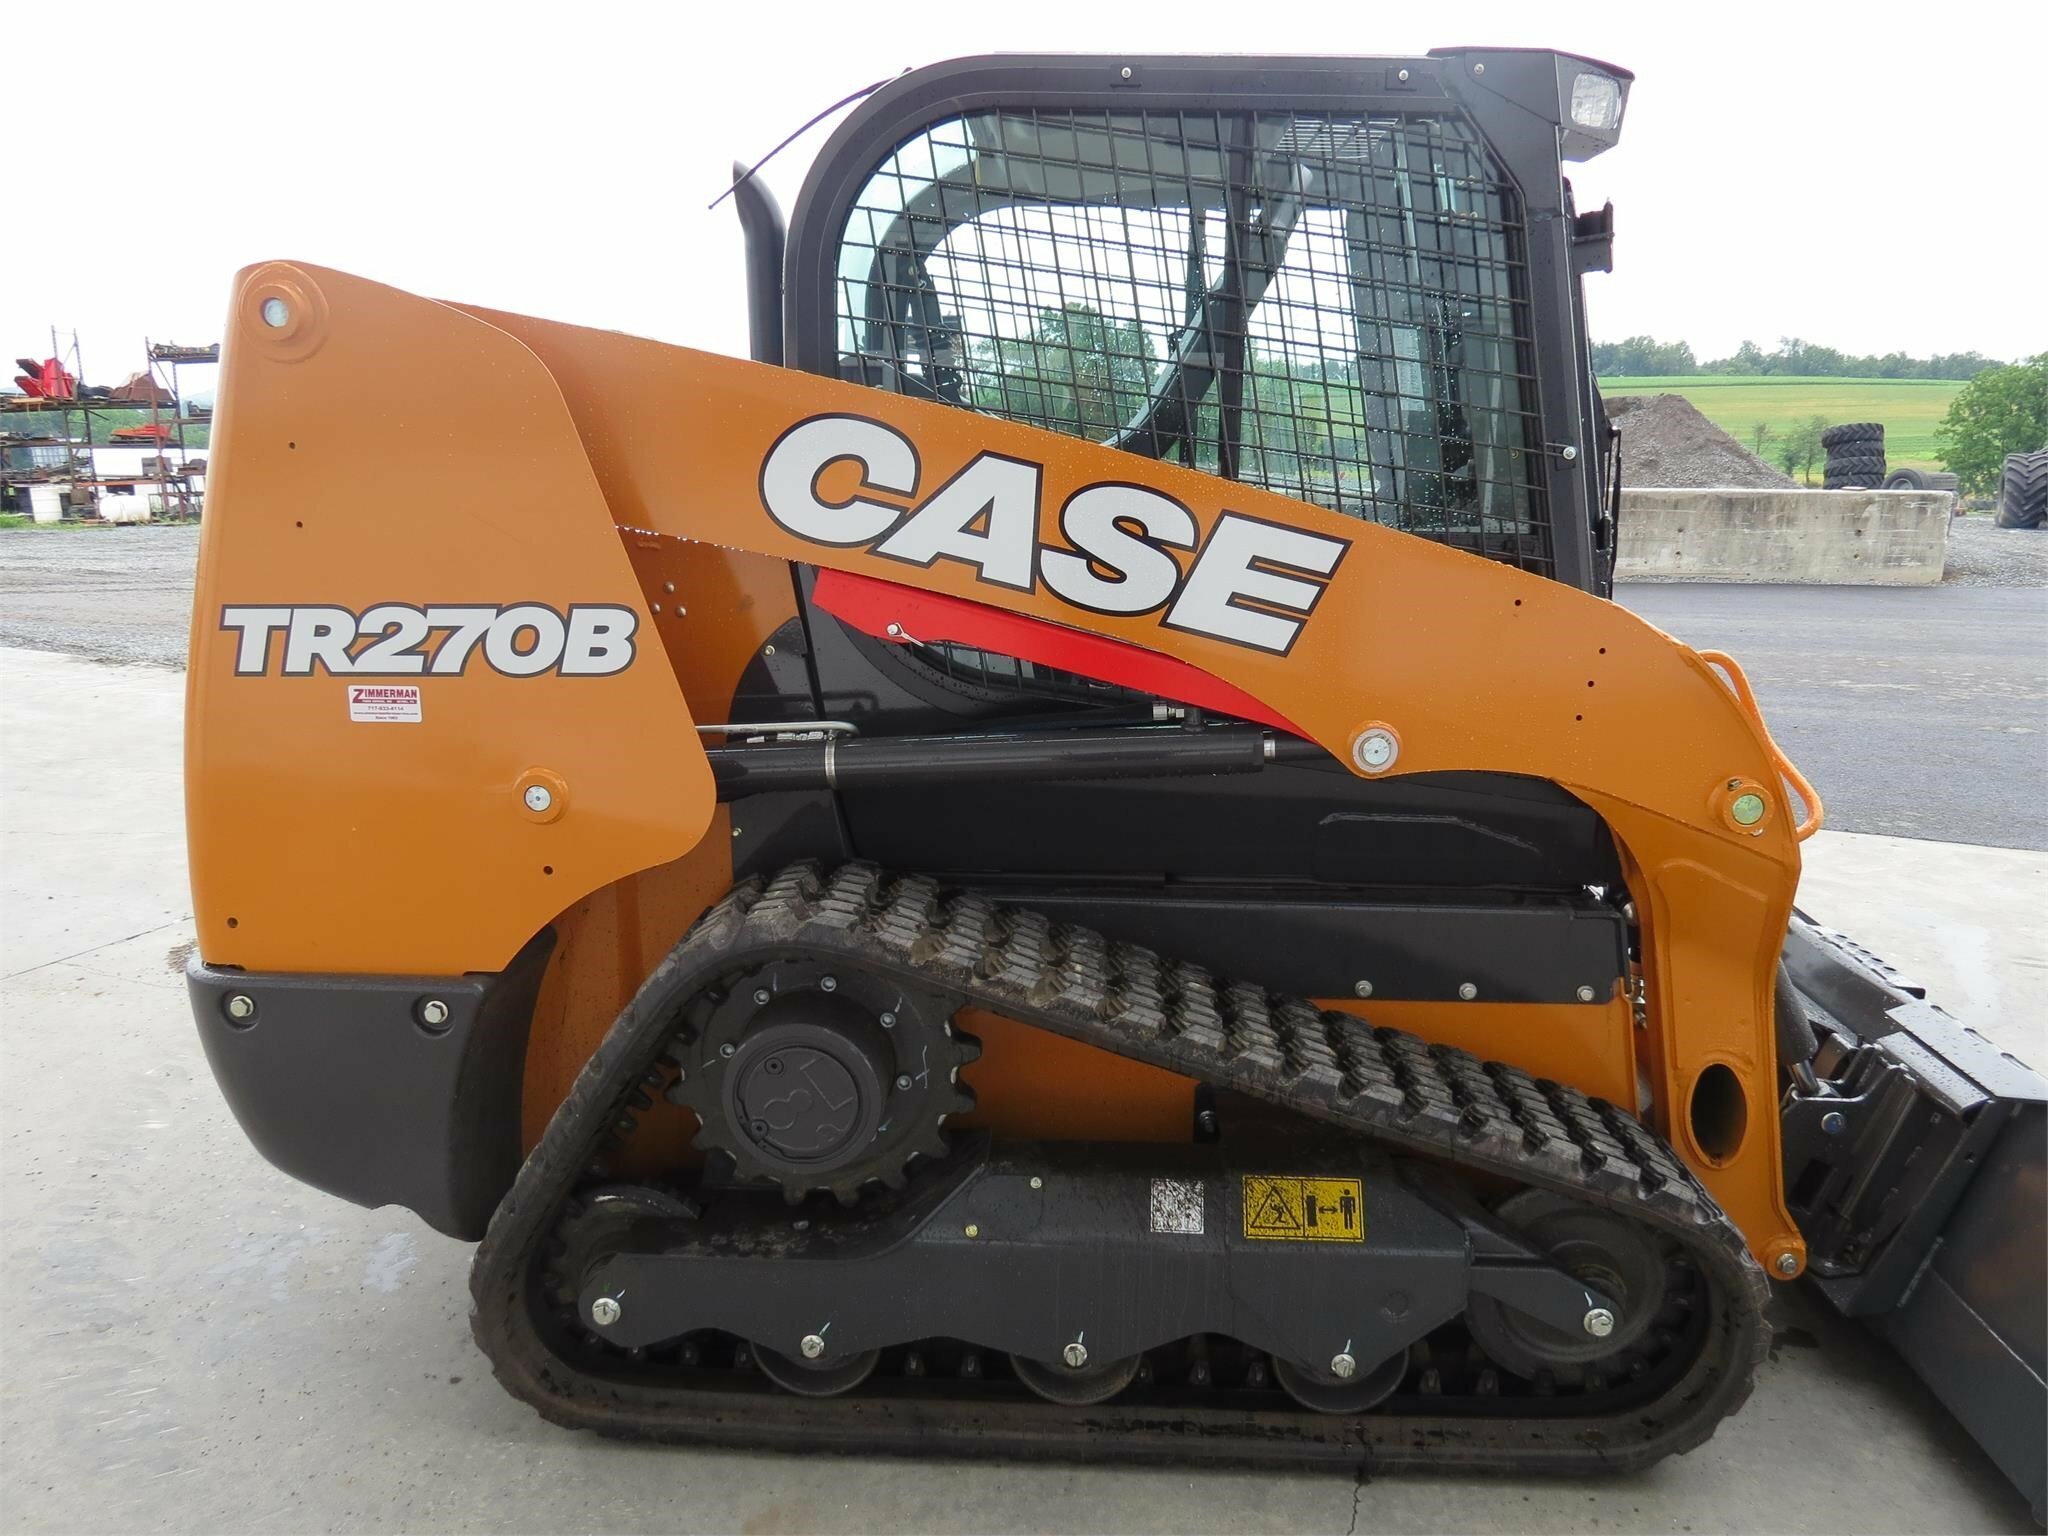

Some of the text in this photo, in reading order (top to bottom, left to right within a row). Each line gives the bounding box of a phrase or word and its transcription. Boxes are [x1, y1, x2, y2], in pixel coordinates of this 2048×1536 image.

[759, 412, 1353, 657] CASE
[220, 602, 640, 678] TR270B
[352, 688, 417, 704] ZIMMERMAN
